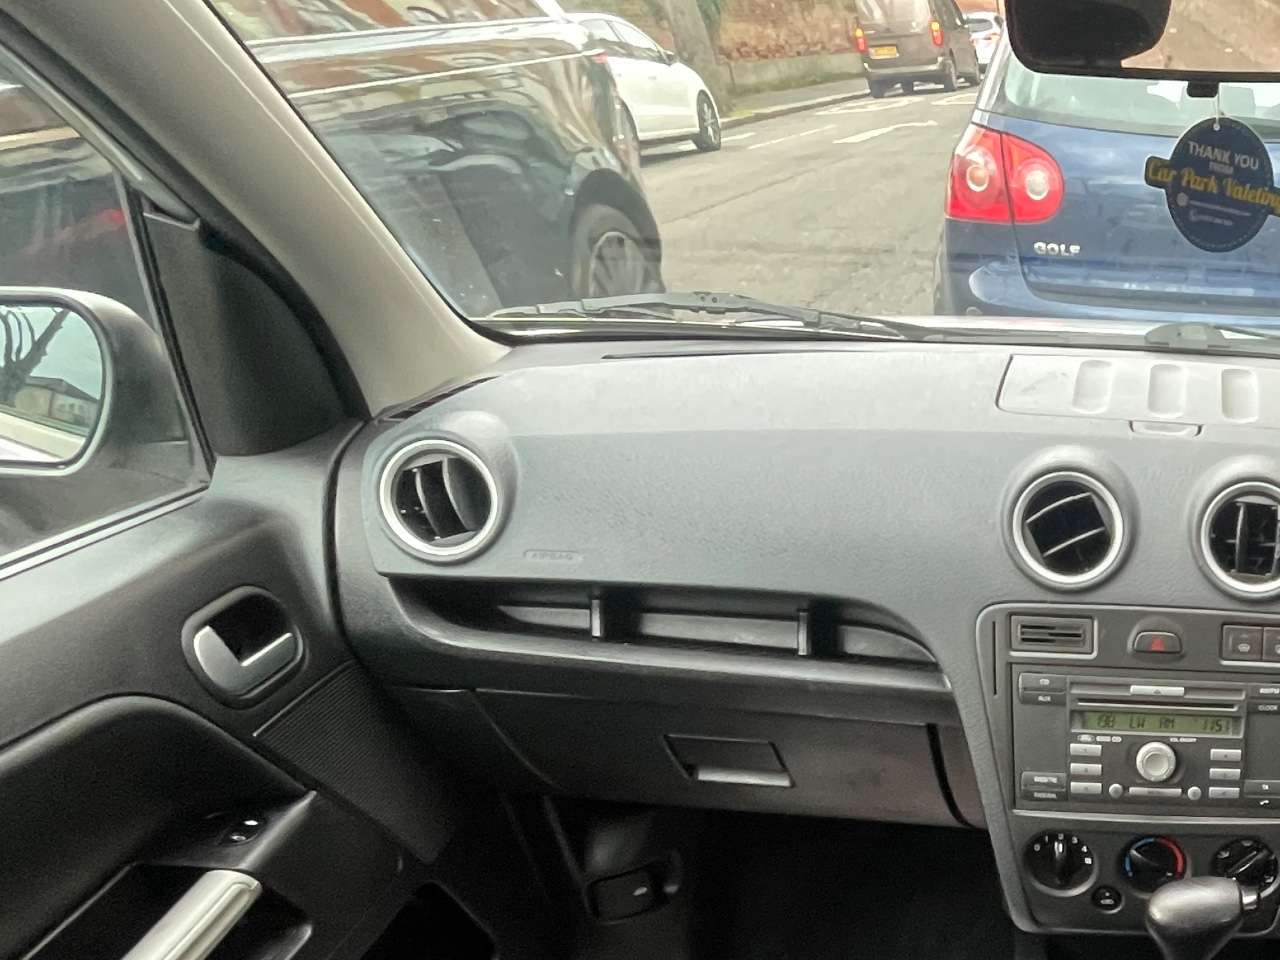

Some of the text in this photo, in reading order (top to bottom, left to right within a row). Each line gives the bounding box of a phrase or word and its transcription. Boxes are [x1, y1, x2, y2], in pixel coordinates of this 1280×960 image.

[1188, 141, 1260, 170] THANK YOU
[1148, 159, 1177, 184] Car
[1180, 166, 1218, 193] Park
[1033, 241, 1081, 256] GOLF
